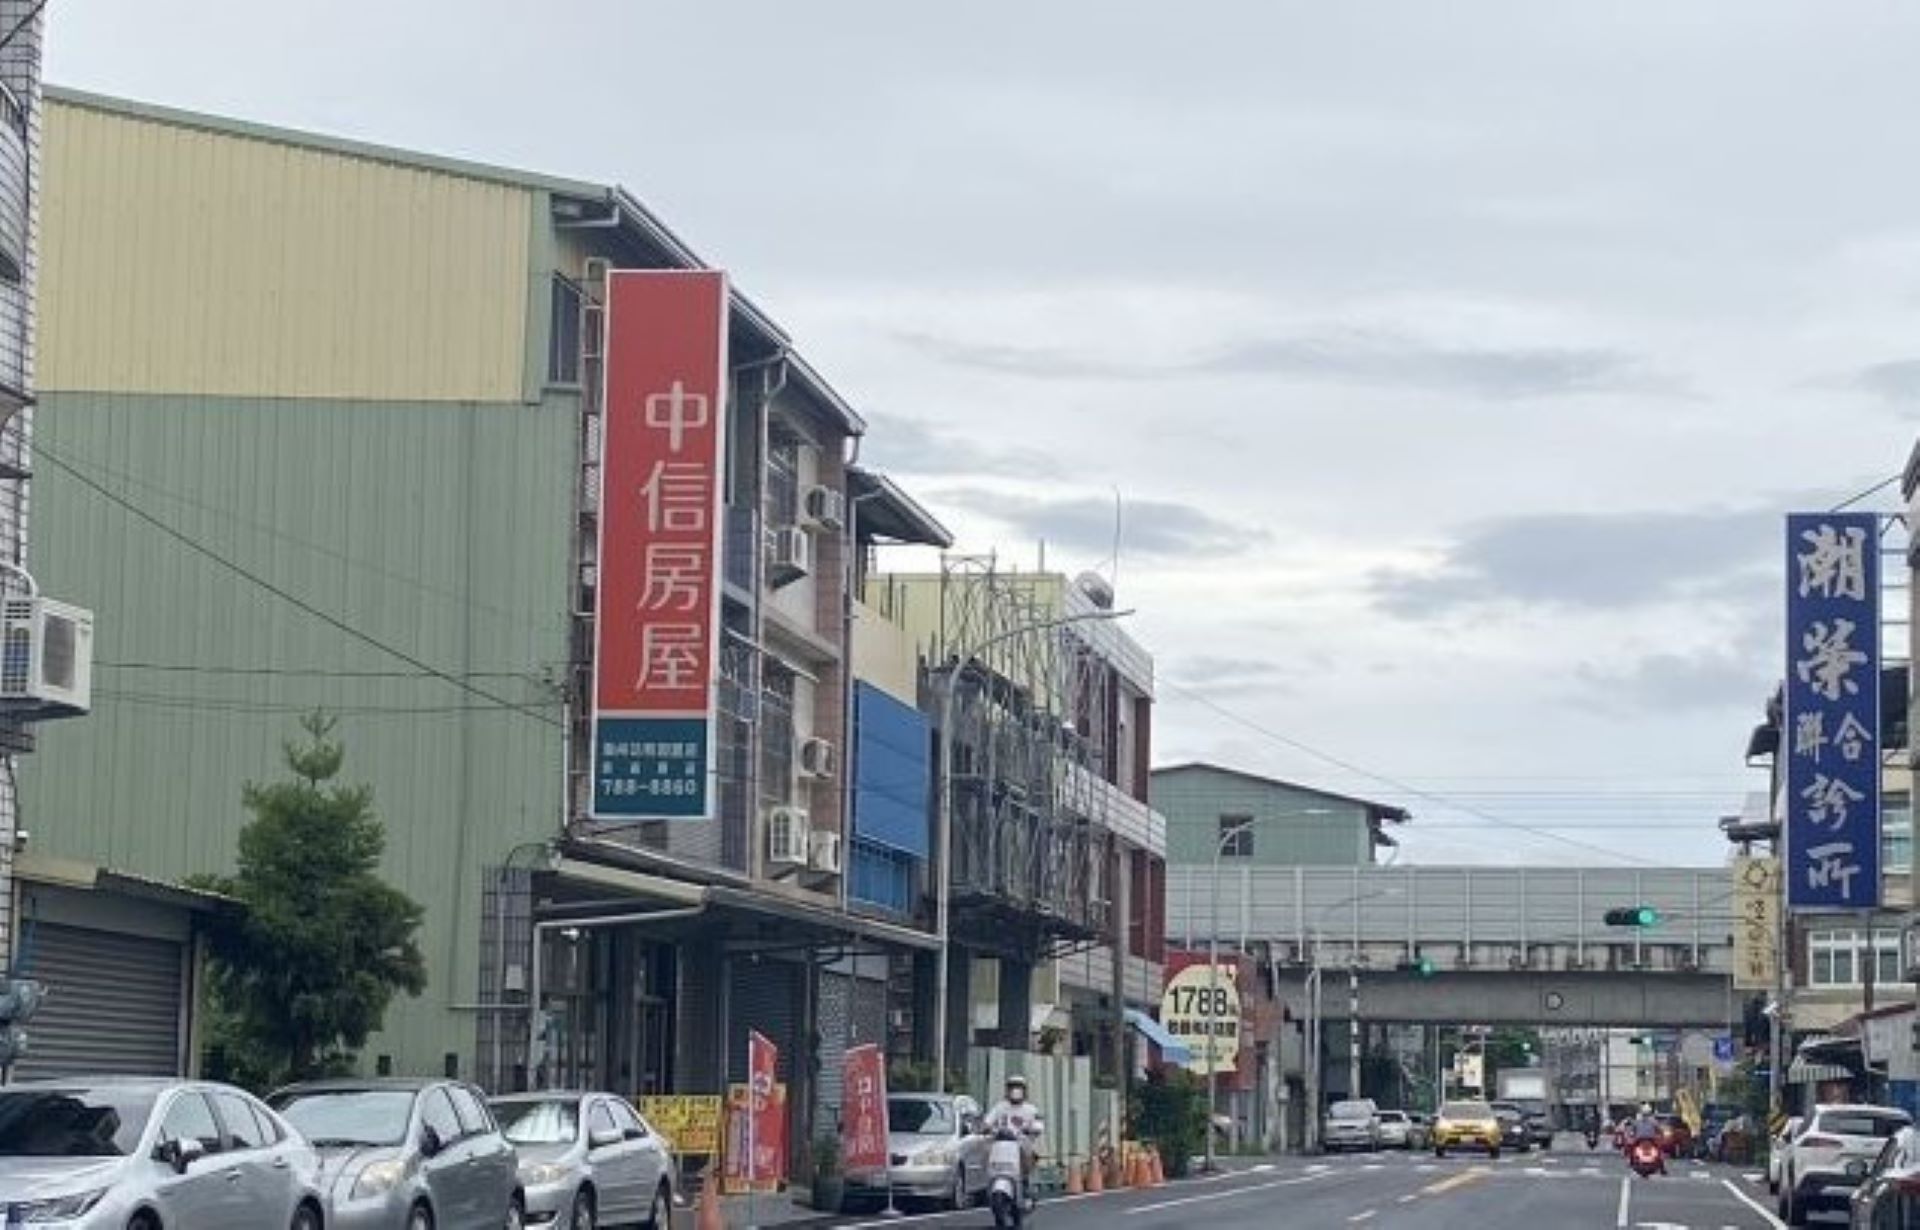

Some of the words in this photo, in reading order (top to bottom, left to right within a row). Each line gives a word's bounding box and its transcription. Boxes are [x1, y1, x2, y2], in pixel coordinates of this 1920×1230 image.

[636, 381, 709, 691] 中信房屋
[1168, 985, 1227, 1016] 1788
